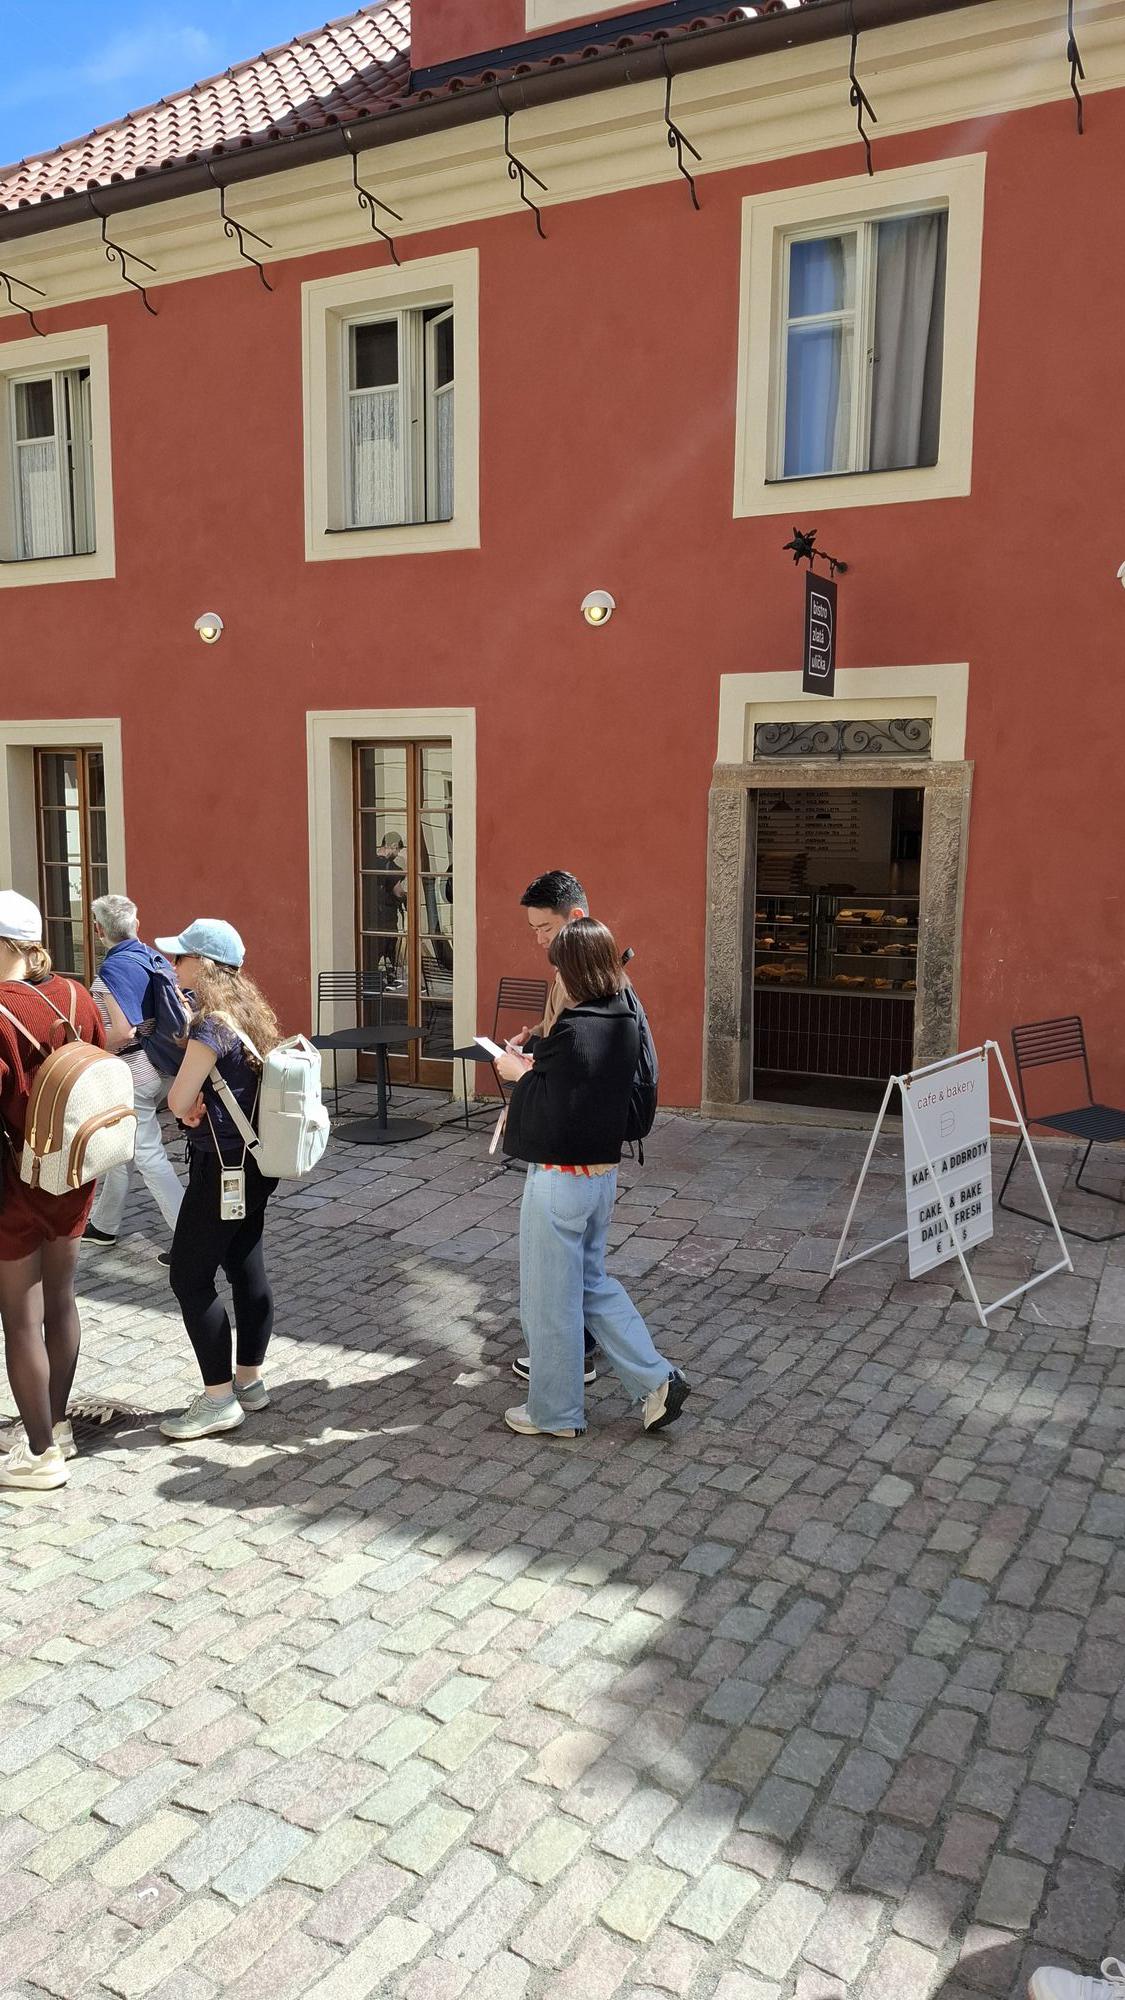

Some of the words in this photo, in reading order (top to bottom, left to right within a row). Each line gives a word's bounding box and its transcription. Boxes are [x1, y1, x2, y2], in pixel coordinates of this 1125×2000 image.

[813, 599, 828, 619] bistro
[812, 627, 825, 644] zlatá
[917, 1092, 937, 1110] cafe
[938, 1091, 945, 1102] &
[946, 1079, 975, 1098] bakery
[941, 1160, 948, 1174] A
[950, 1142, 988, 1169] DOBROTY
[920, 1202, 942, 1223] CAKE
[949, 1196, 956, 1209] &
[960, 1183, 982, 1203] BAKE
[954, 1202, 982, 1225] FRESH
[936, 1241, 942, 1253] €
[962, 1229, 968, 1240] $
